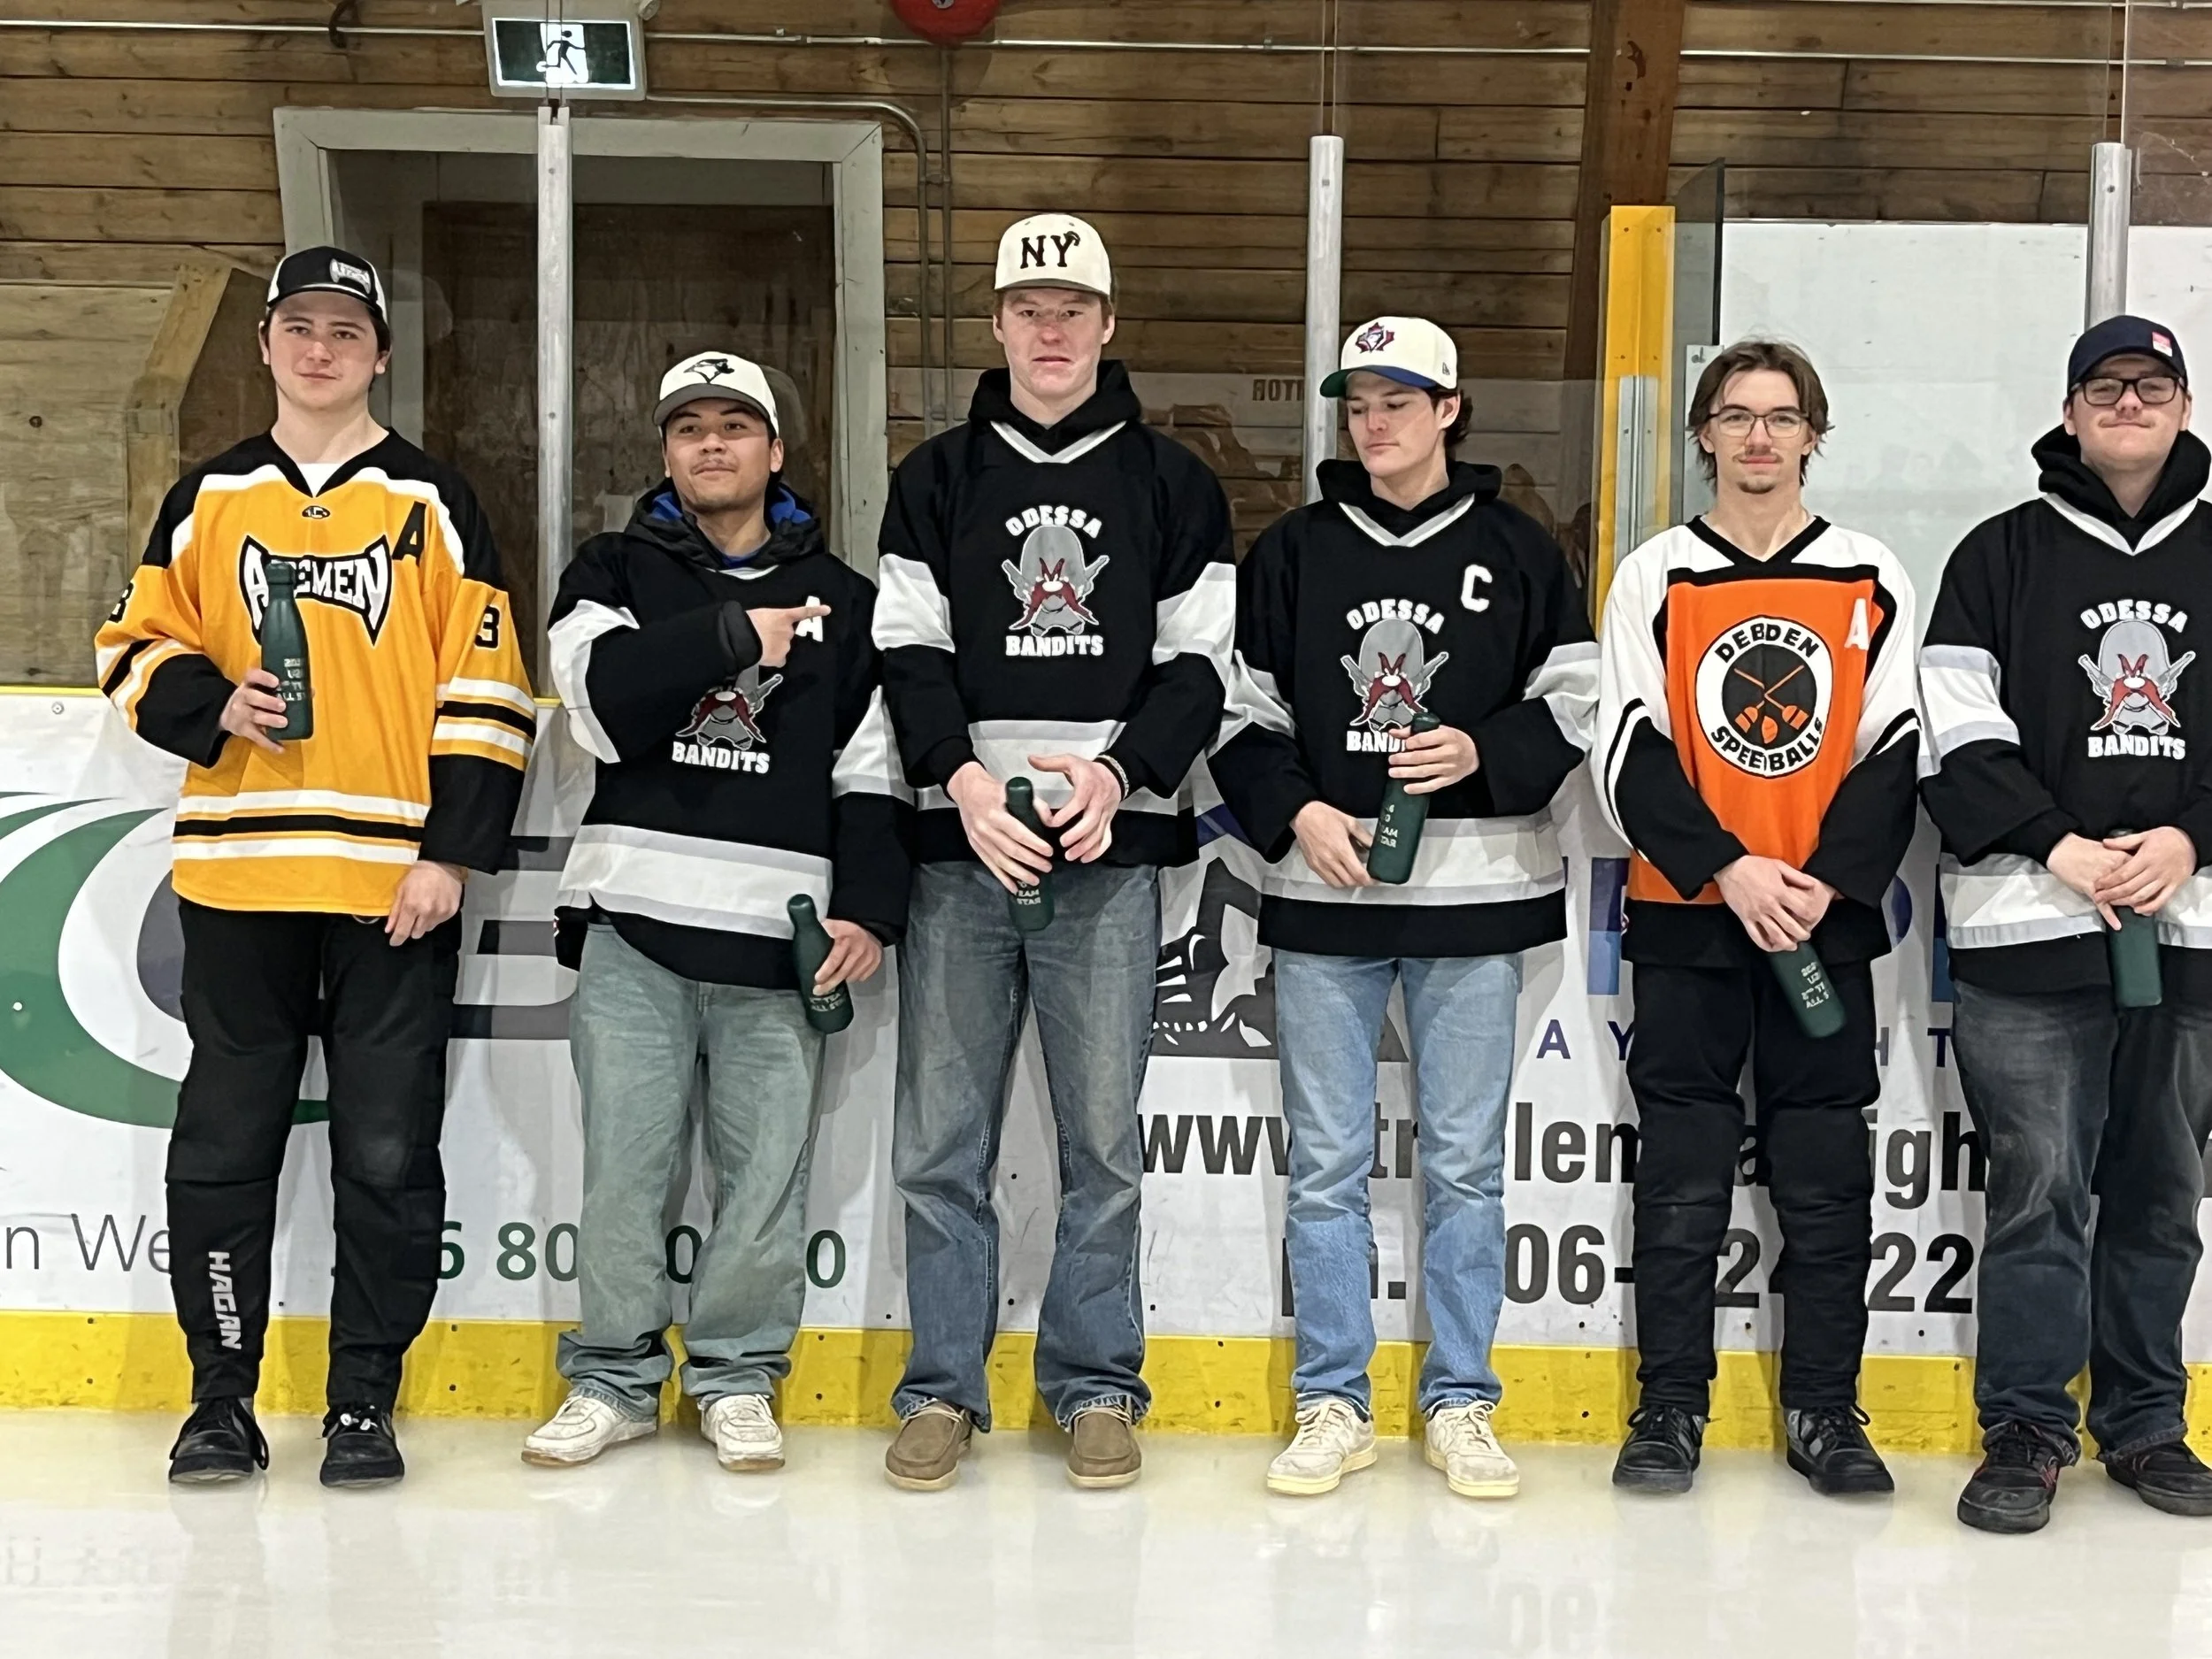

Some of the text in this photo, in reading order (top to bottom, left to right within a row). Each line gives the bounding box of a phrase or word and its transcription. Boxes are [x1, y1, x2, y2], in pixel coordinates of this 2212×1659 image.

[1020, 231, 1080, 269] NY
[392, 501, 426, 567] A
[1005, 505, 1102, 539] ODESSA
[240, 534, 392, 646] AEMEN
[1461, 564, 1493, 612] C
[795, 595, 823, 642] A
[1346, 598, 1445, 634] ODESSA
[1844, 597, 1872, 651] A
[2080, 598, 2188, 634] ODESSA
[1005, 634, 1104, 657] BANDITS
[1715, 622, 1820, 664] DEBDEN
[672, 741, 771, 775] BANDITS
[1346, 730, 1406, 753] BAND
[2087, 733, 2186, 761] BANDITS
[208, 1251, 242, 1350] HAGAN
